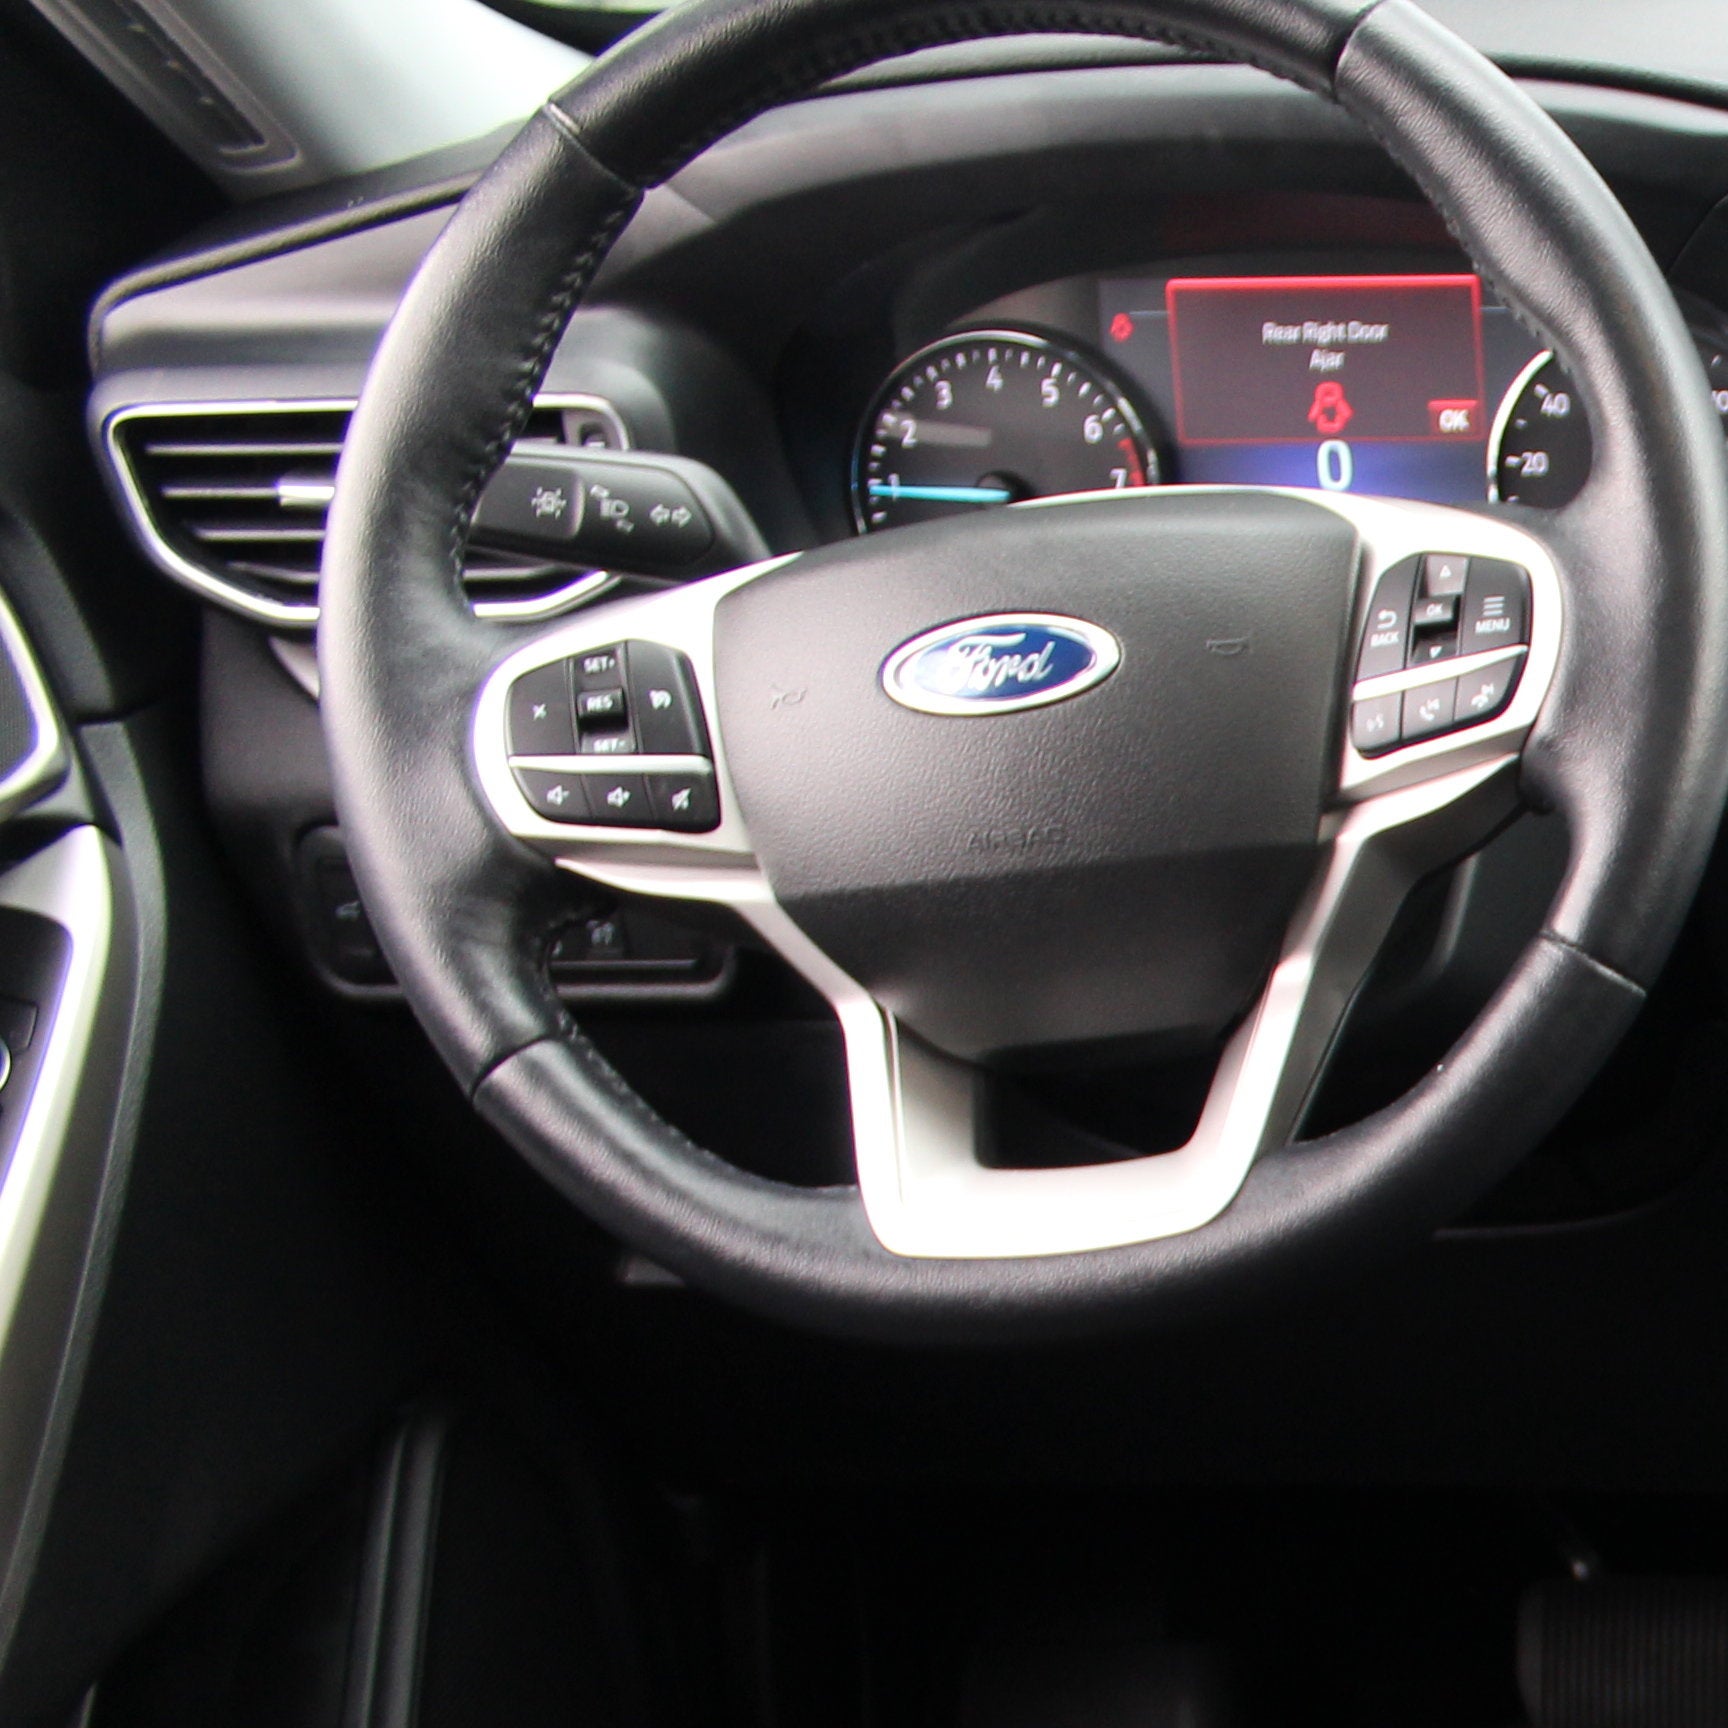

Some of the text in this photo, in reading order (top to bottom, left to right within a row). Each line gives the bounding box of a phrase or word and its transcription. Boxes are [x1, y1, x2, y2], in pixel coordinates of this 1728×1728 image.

[1262, 321, 1389, 347] Rear Right Door
[1309, 349, 1346, 372] Ajar
[986, 364, 1003, 392] 4
[934, 380, 952, 410] 3
[1041, 376, 1060, 408] 5
[1540, 392, 1570, 418] 40
[1083, 414, 1103, 445] 6
[1438, 408, 1470, 433] OK
[900, 419, 919, 449] 2
[1316, 439, 1353, 492] 0
[1520, 451, 1549, 475] 20
[889, 473, 900, 500] 1
[1109, 467, 1128, 489] 7
[1425, 603, 1444, 617] OK
[1474, 617, 1511, 634] MENU
[1369, 631, 1400, 648] BACK
[933, 632, 1056, 693] Ford
[586, 695, 614, 712] RES
